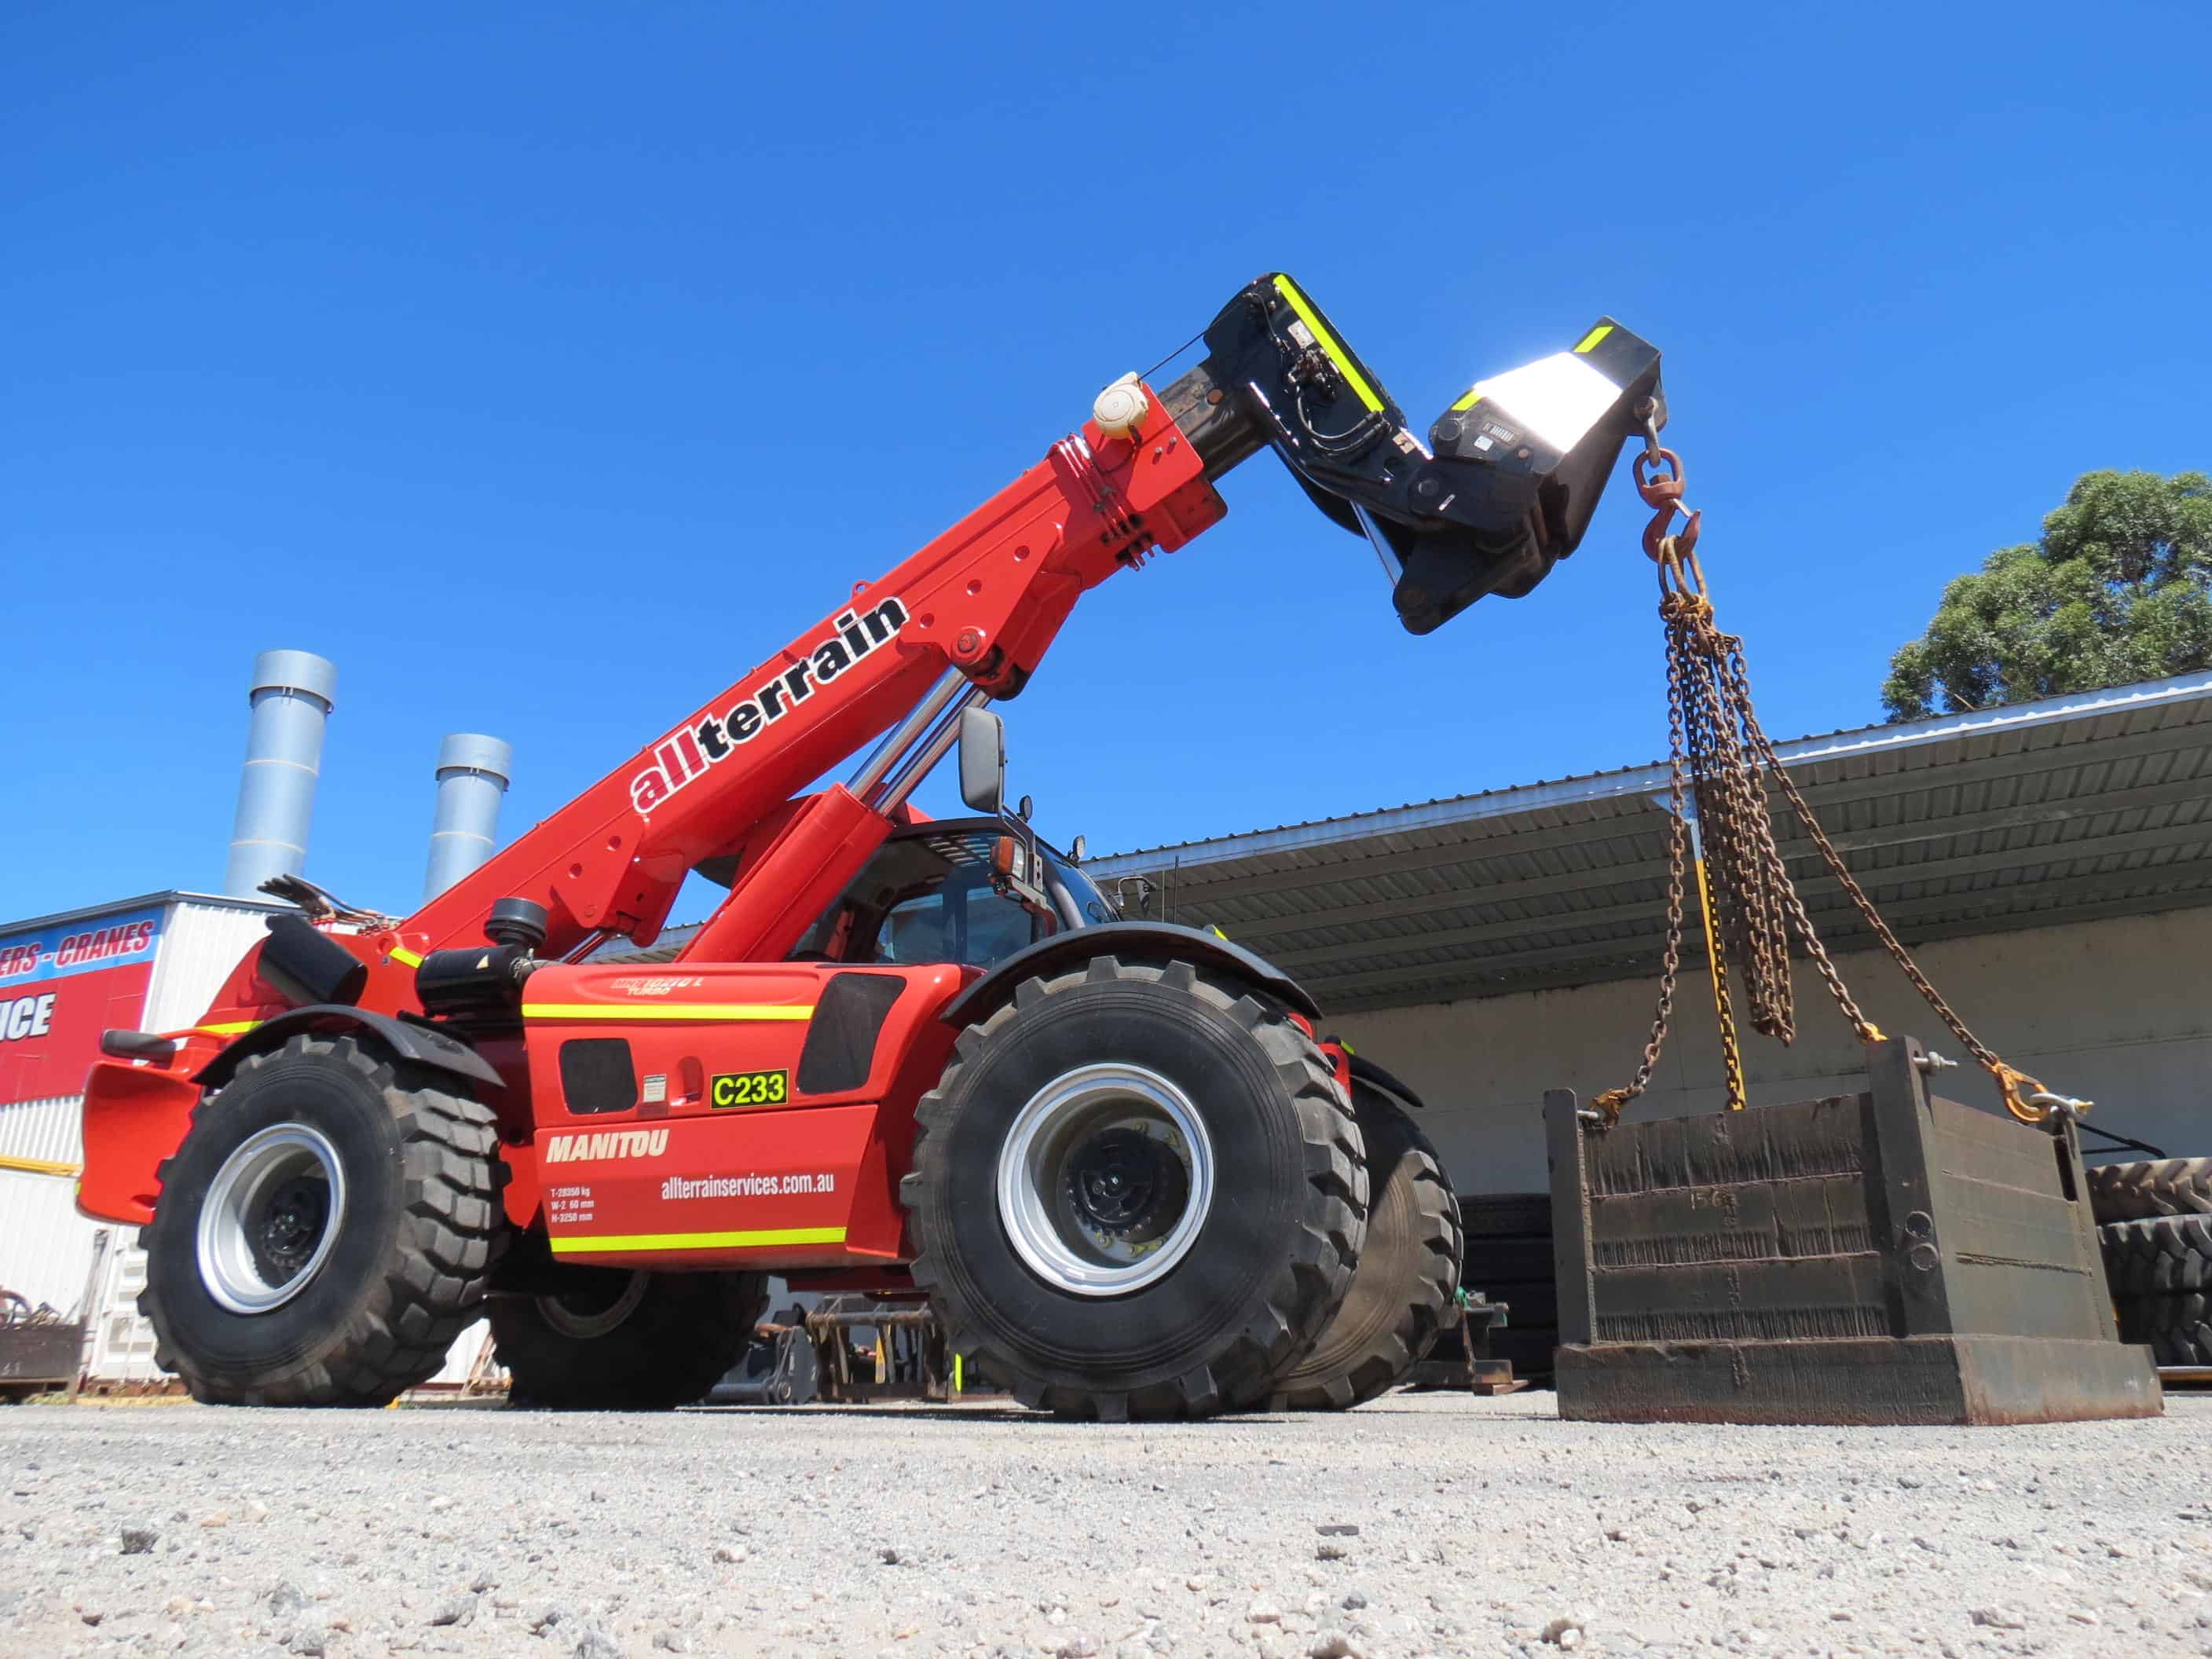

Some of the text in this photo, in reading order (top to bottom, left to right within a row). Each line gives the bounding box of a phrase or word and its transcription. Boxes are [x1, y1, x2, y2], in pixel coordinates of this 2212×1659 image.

[629, 596, 910, 814] allterrain
[55, 920, 155, 968] CRANES
[713, 1073, 785, 1106] C233
[546, 1129, 670, 1163] MANITOU
[581, 1186, 591, 1198] kg
[661, 1172, 835, 1200] allterrainservices.com.au
[579, 1213, 593, 1222] mm
[580, 1200, 595, 1209] mm
